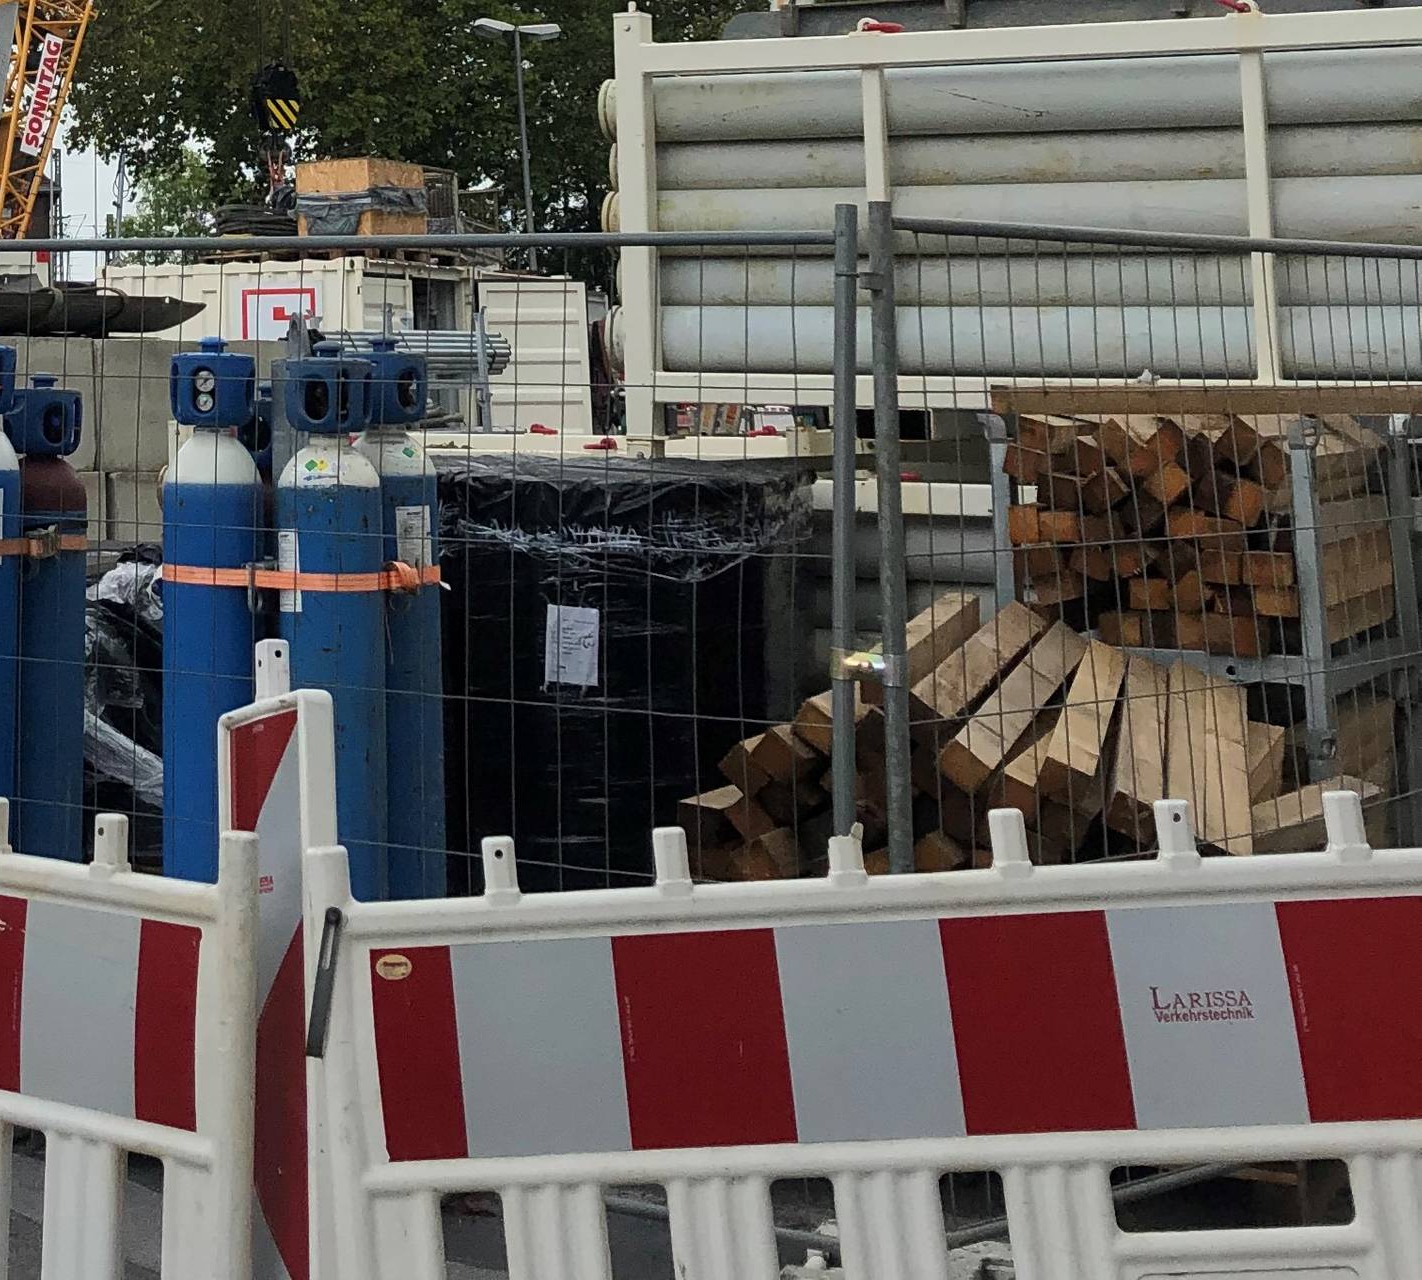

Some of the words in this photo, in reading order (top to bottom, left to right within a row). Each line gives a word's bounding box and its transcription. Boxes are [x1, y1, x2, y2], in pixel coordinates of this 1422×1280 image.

[25, 39, 61, 148] SONNTAG
[1149, 986, 1252, 1010] LARISSA
[1152, 1008, 1255, 1023] Verkehrstechnik
